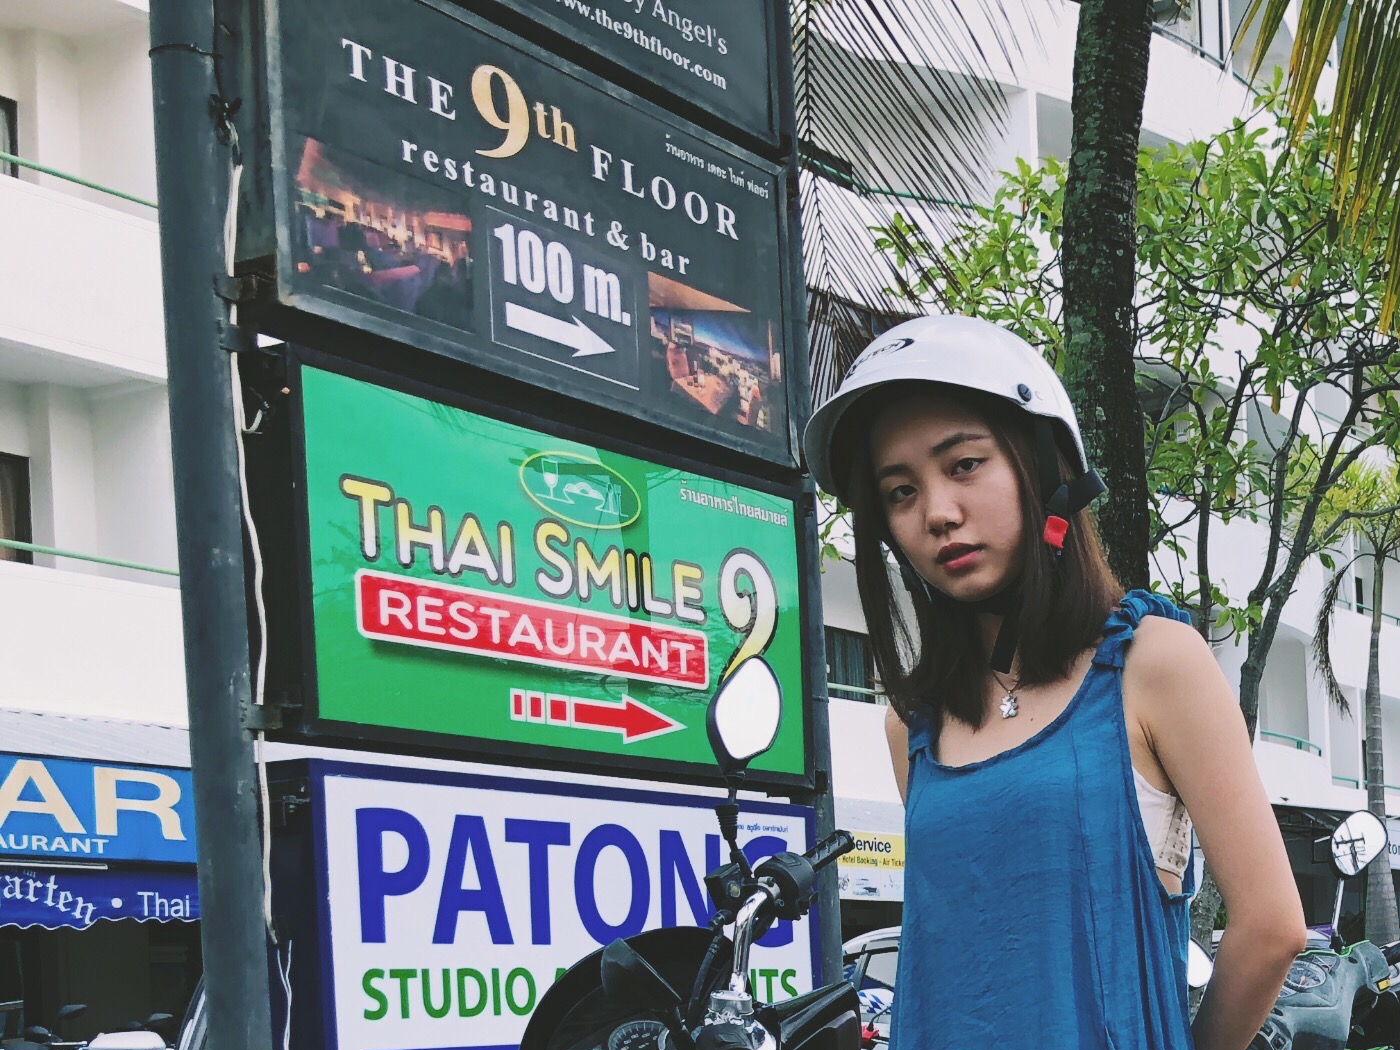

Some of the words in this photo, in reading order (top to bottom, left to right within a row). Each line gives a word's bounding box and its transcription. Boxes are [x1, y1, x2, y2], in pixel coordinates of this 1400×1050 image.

[556, 0, 728, 90] ww.the9thfloor.com
[652, 0, 728, 55] Angel's
[341, 38, 456, 122] THE
[470, 63, 579, 159] 9th
[590, 144, 739, 242] FLOOR
[401, 139, 595, 238] restaurant
[606, 221, 630, 252] &
[640, 238, 691, 275] bar
[494, 223, 575, 304] 100
[583, 264, 632, 327] m.
[679, 478, 789, 527] ร้านอาหารไทยสมายล์
[340, 473, 515, 587] THAI
[533, 519, 707, 623] SMILE
[378, 589, 695, 675] RESTAURANT
[0, 759, 187, 841] AR
[355, 807, 795, 948] PATONG
[842, 855, 855, 864] Hotel
[857, 856, 878, 866] Booking
[852, 837, 892, 853] ervice
[0, 874, 97, 925] arten
[137, 891, 190, 917] Thai
[361, 966, 537, 1021] STUDIO
